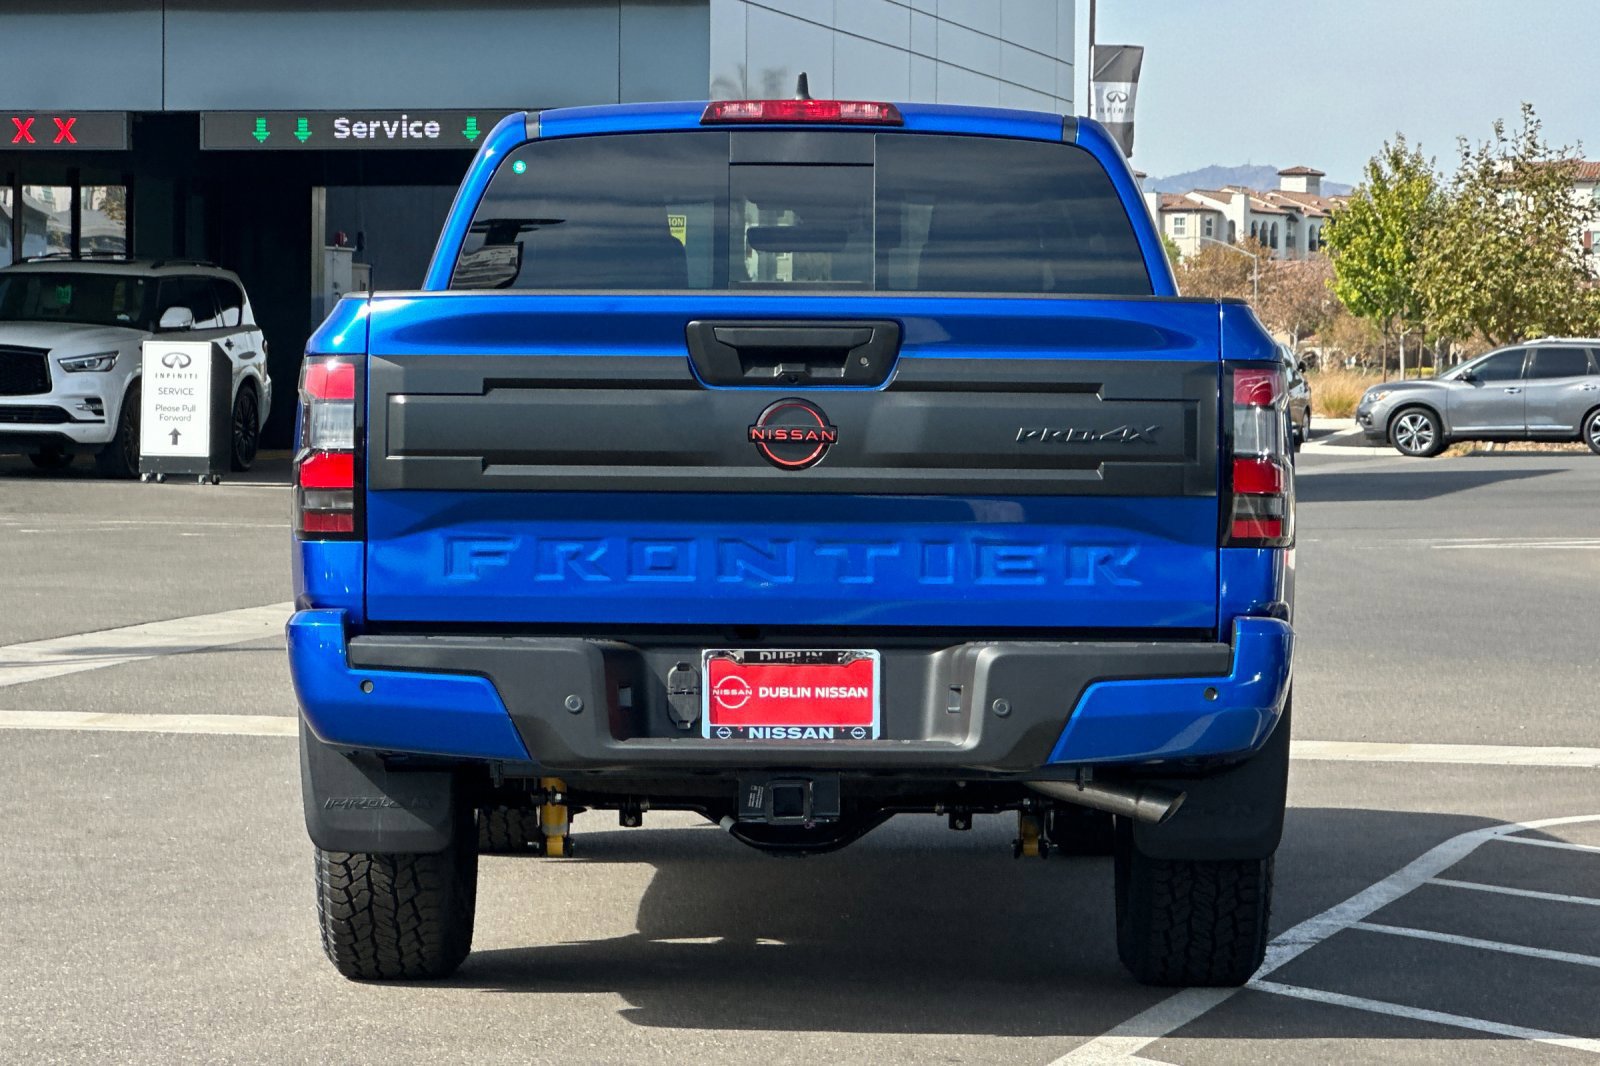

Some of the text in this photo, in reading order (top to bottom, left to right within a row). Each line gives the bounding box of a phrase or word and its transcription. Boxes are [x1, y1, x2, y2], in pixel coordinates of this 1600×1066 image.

[333, 114, 441, 139] Service
[157, 387, 194, 396] SERVICE
[155, 403, 197, 413] Please Pull
[159, 413, 192, 422] Forward
[751, 428, 834, 441] NISSAN
[445, 535, 1142, 586] FRONTIER
[758, 686, 868, 698] DUBLIN NISSAN
[748, 727, 834, 739] NISSAN
